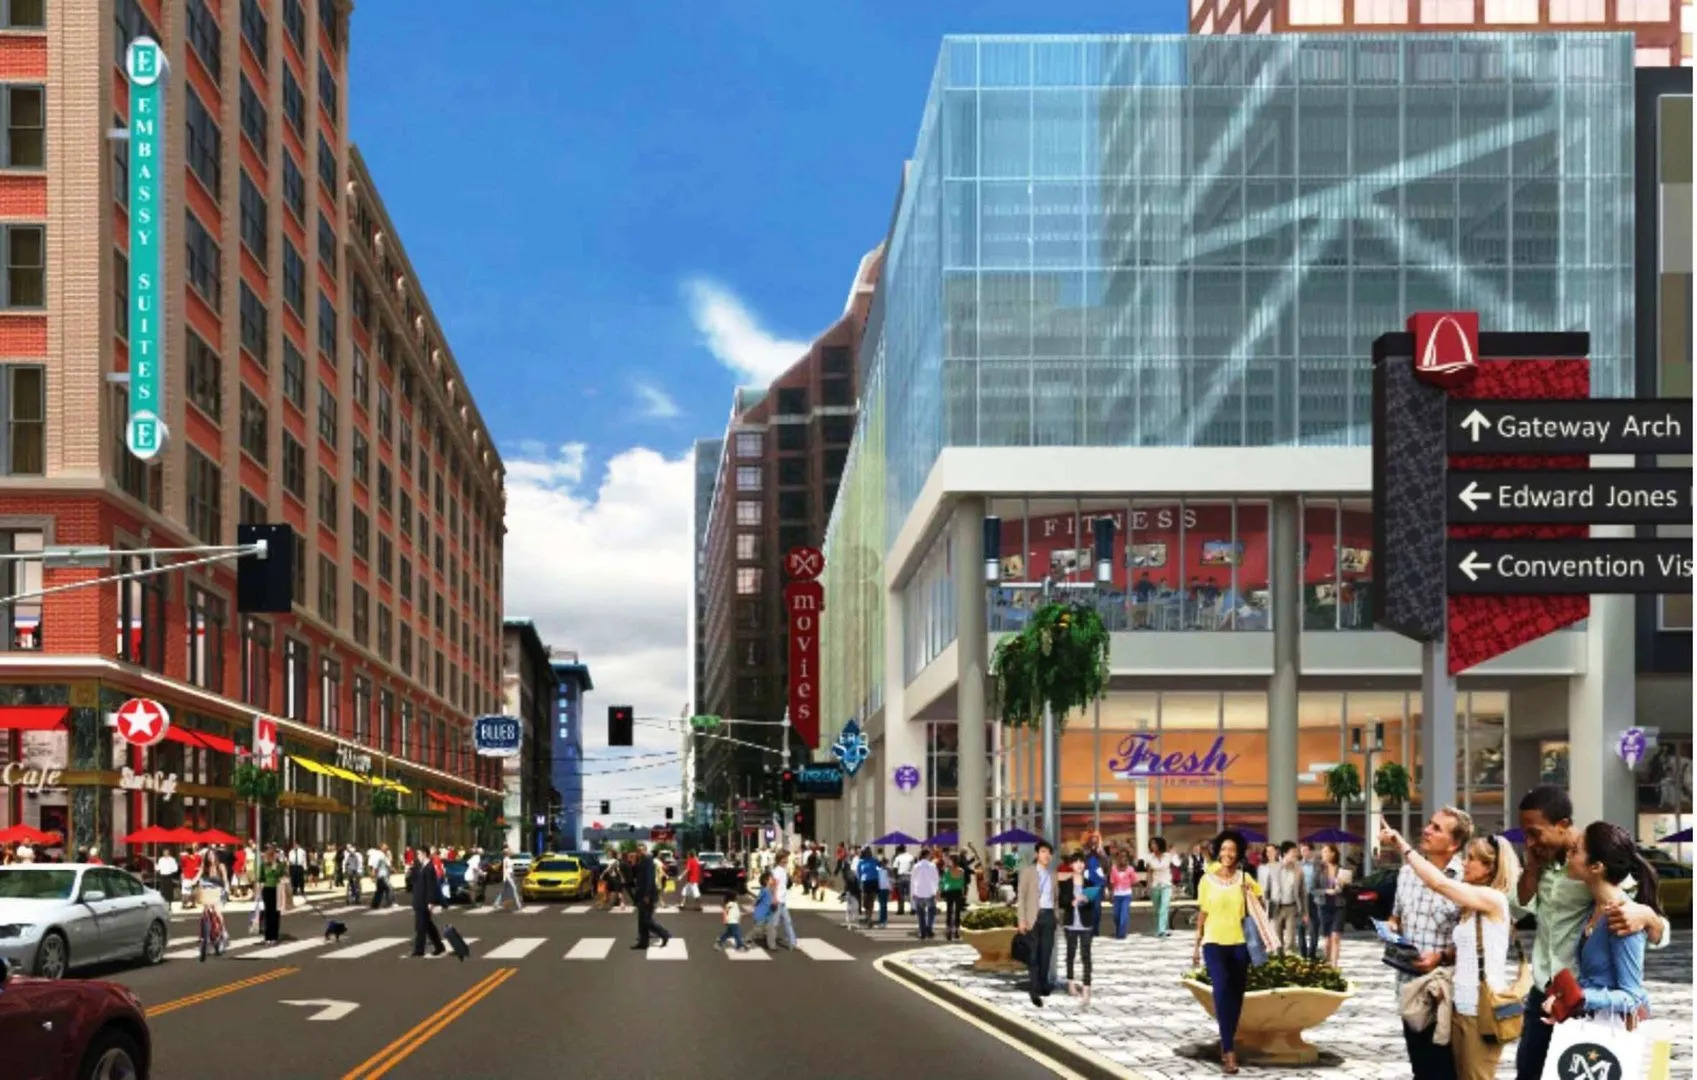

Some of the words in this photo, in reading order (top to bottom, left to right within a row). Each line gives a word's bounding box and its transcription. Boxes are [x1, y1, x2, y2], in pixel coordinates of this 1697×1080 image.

[135, 97, 153, 246] EMBASSY
[136, 273, 153, 401] SUITES
[1497, 414, 1611, 443] Gateway
[1622, 412, 1682, 438] Arch
[1498, 483, 1594, 508] Edward
[1605, 485, 1678, 508] Jones
[1044, 509, 1197, 537] FITNESS
[1497, 554, 1645, 578] Convention
[793, 594, 816, 720] movies
[1109, 733, 1241, 773] Fresh
